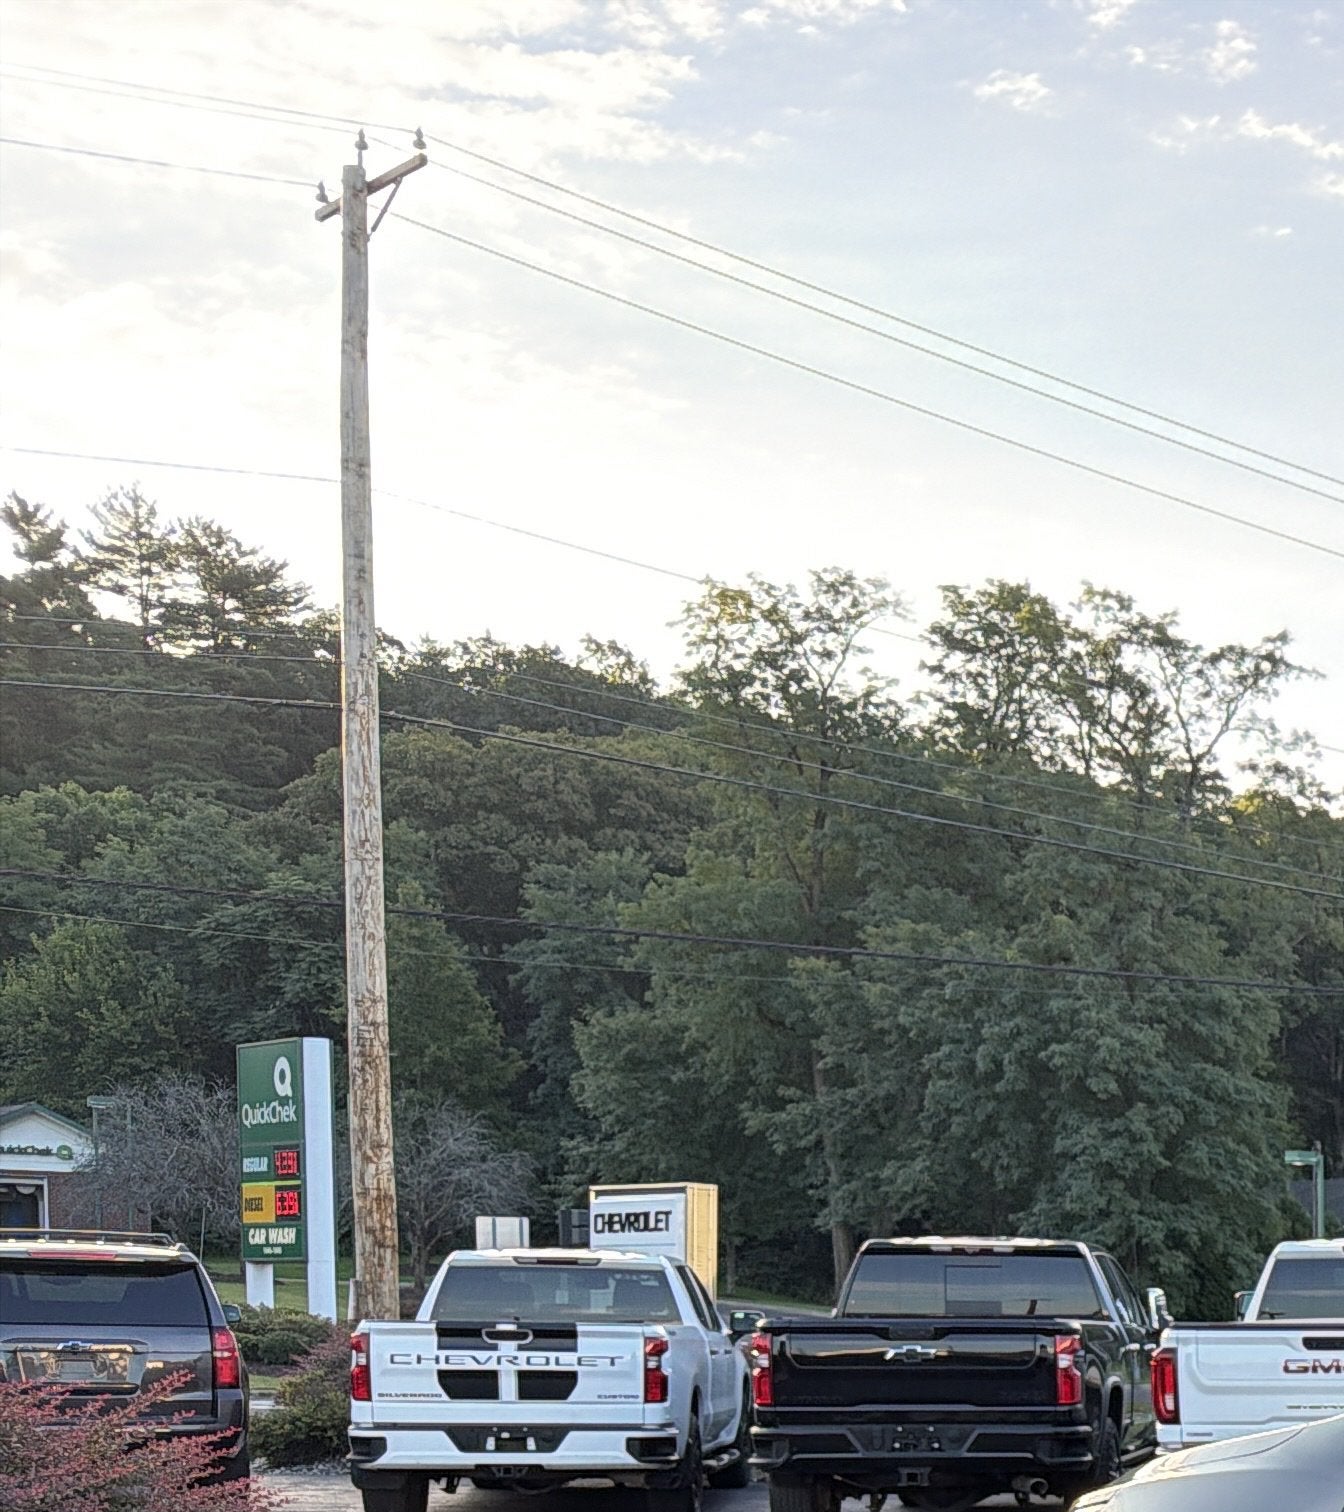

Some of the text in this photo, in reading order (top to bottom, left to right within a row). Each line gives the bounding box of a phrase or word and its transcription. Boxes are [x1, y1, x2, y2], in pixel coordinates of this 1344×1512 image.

[273, 1056, 293, 1097] Q
[241, 1099, 298, 1129] QuickChek
[593, 1209, 673, 1234] CHEVROLET
[248, 1227, 296, 1245] CAR WASH
[389, 1353, 625, 1368] CHEVROLET
